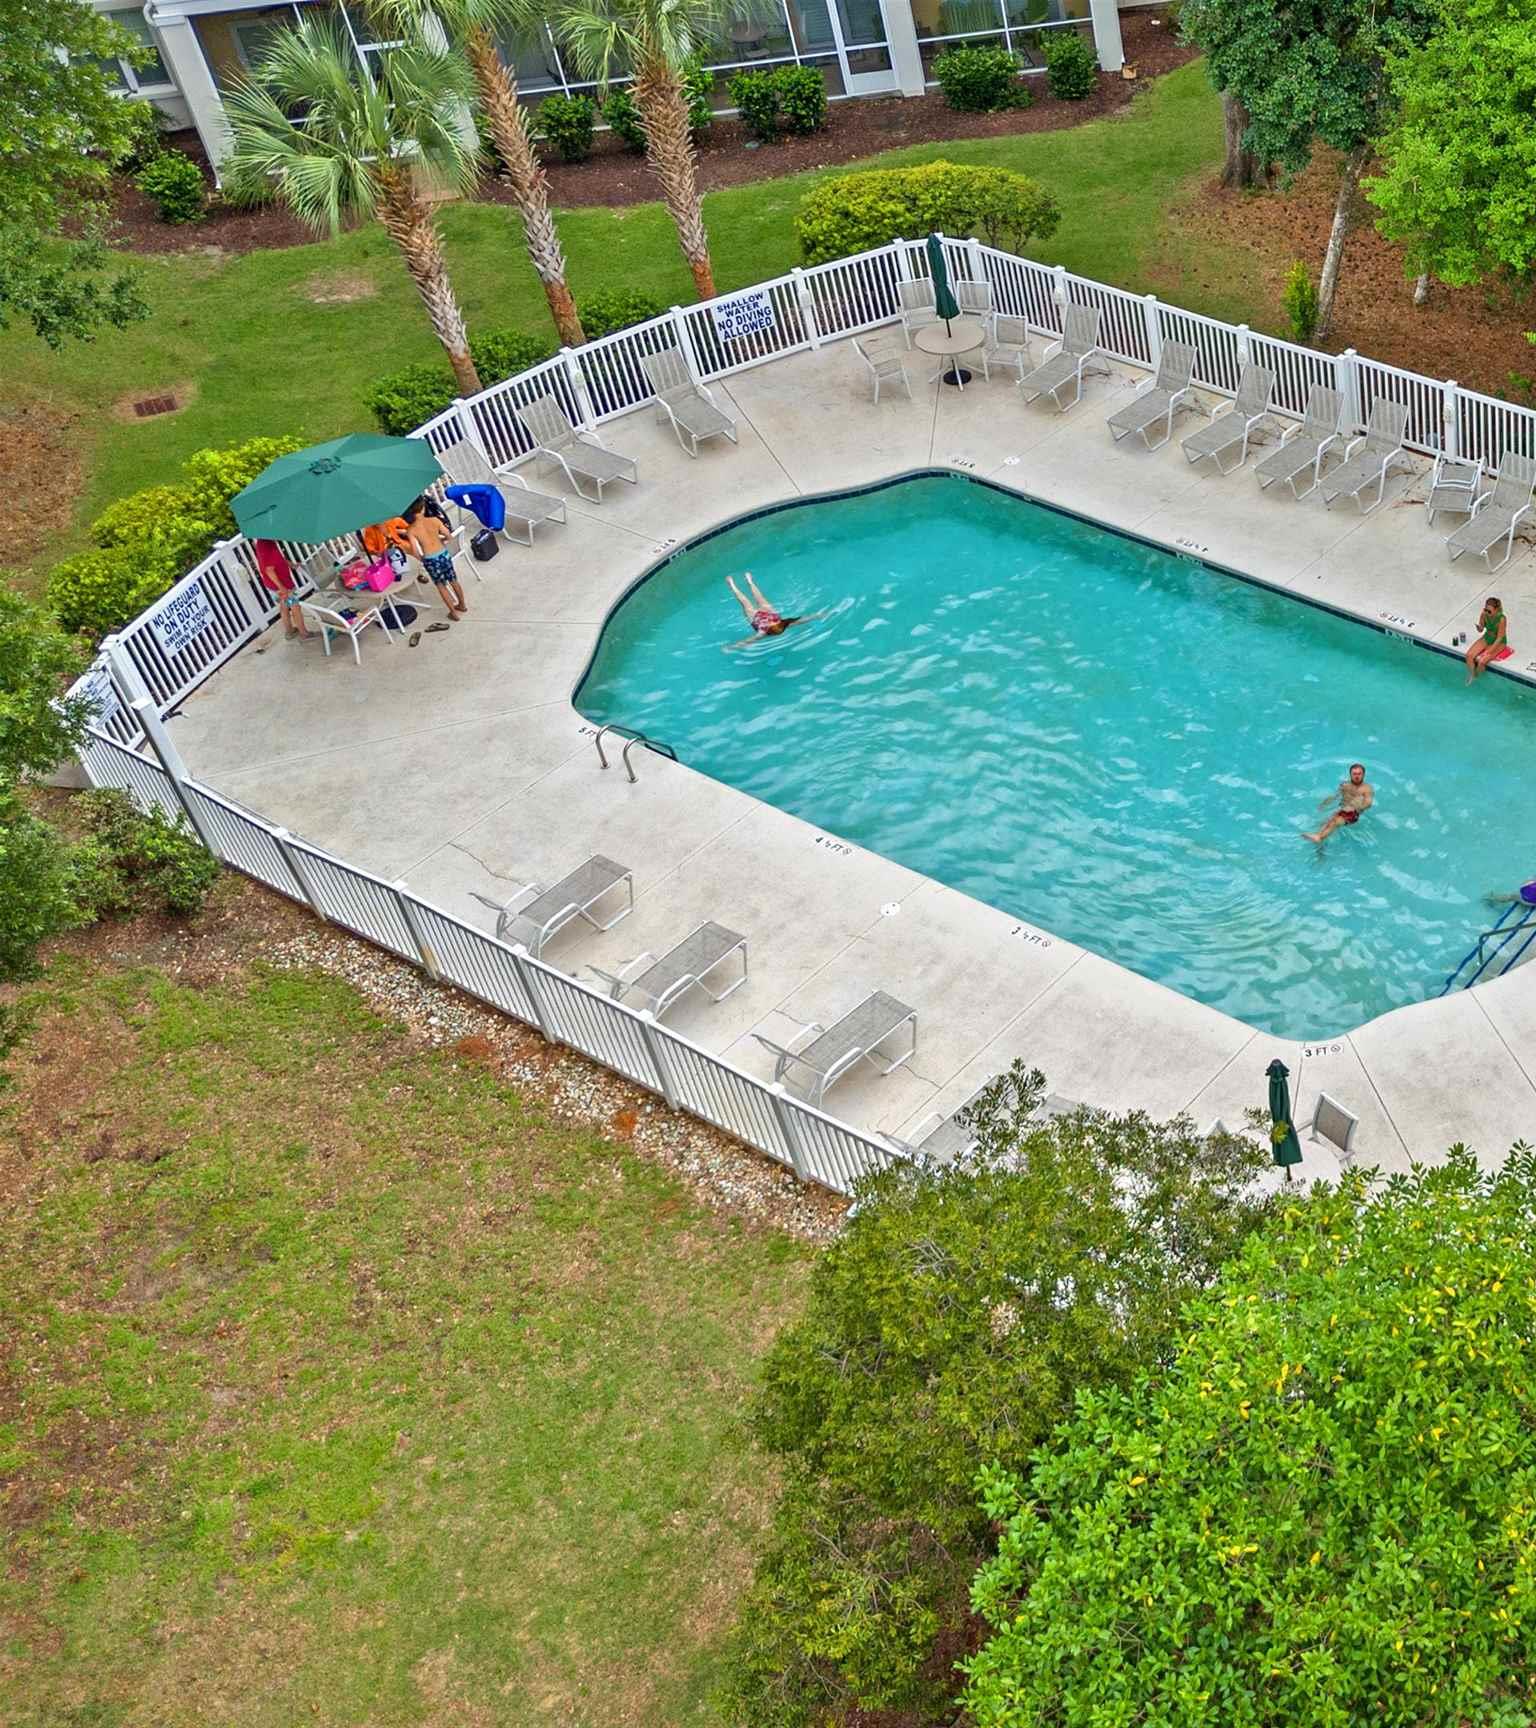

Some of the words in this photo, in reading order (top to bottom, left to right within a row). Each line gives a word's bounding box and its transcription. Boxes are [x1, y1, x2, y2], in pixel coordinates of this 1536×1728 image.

[717, 292, 763, 312] SHALLOW
[725, 302, 759, 317] WATER
[718, 319, 733, 331] NO
[736, 306, 772, 325] DIVING
[724, 317, 772, 340] ALLOWED
[152, 615, 164, 629] NO
[163, 583, 200, 620] LIFEGUARD
[164, 619, 178, 635] ON
[177, 599, 200, 623] DUTY
[165, 629, 182, 648] SWIM
[183, 621, 191, 632] AT
[191, 605, 210, 623] YOUR
[175, 634, 191, 649] OWN
[190, 619, 208, 634] RISK
[1305, 1048, 1312, 1057] 3
[1316, 1046, 1328, 1056] FT
